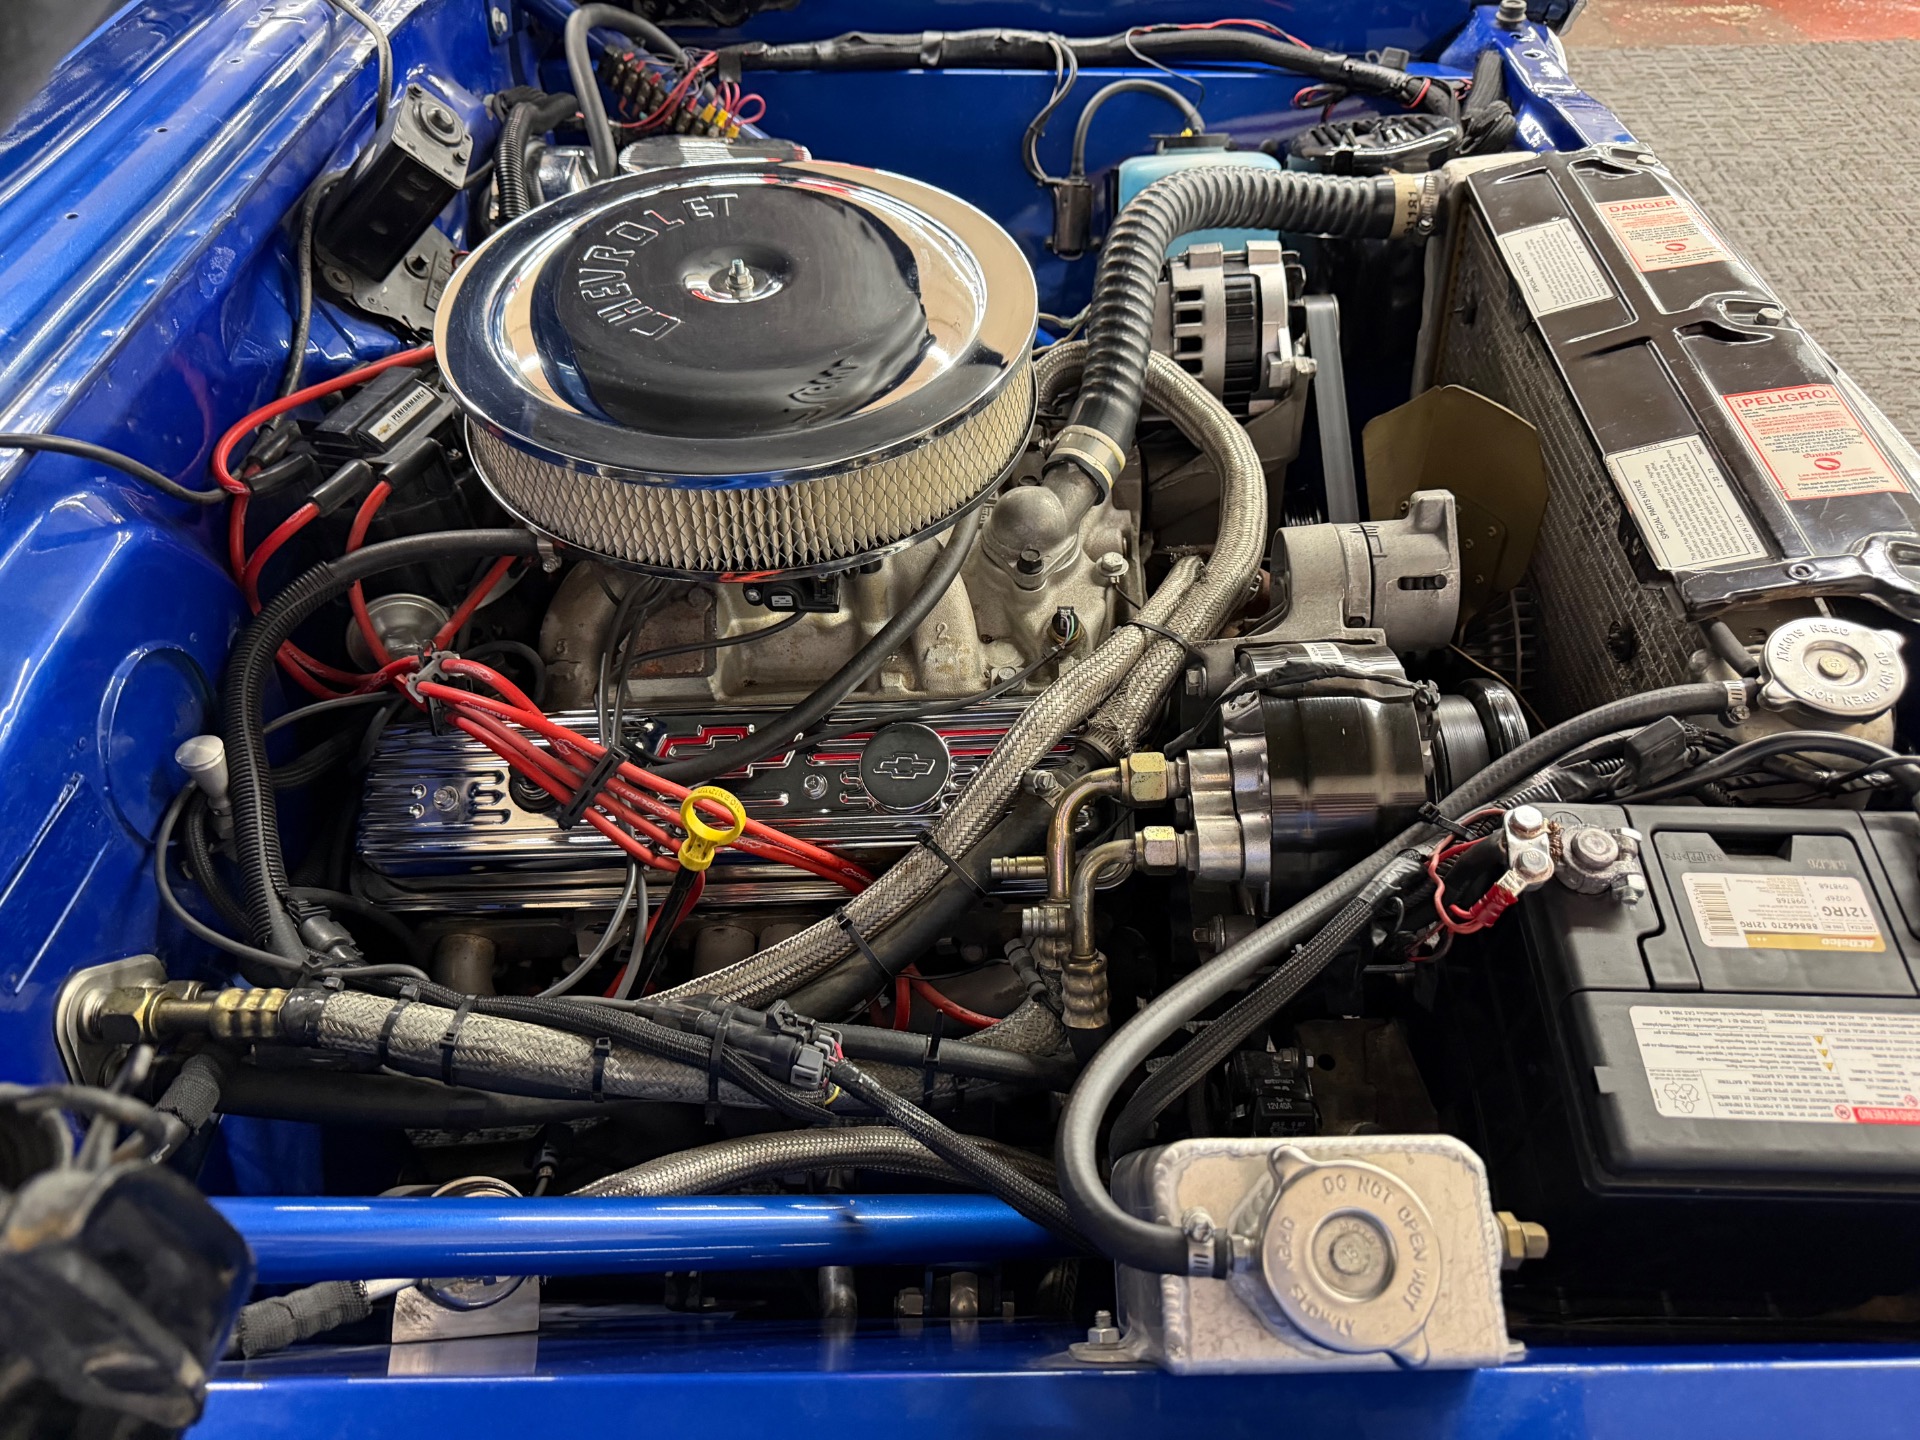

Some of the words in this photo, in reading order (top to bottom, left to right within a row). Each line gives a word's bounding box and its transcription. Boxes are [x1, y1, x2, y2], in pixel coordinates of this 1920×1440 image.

[1609, 199, 1678, 213] DANGER
[578, 193, 738, 341] CHEVROLET
[1735, 389, 1832, 409] ¡PELIGRO!
[1632, 479, 1648, 498] NOTICE
[1642, 498, 1657, 516] PARTS
[1651, 516, 1669, 539] SPECIAL
[1804, 686, 1836, 704] HOT
[1842, 691, 1880, 706] OPEN
[1820, 906, 1868, 917] 121RG
[1819, 937, 1877, 947] ACDelco
[1322, 1175, 1347, 1195] DO
[1357, 1175, 1394, 1204] NOT
[1398, 1206, 1427, 1262] OPEN
[1403, 1269, 1427, 1312] HOT
